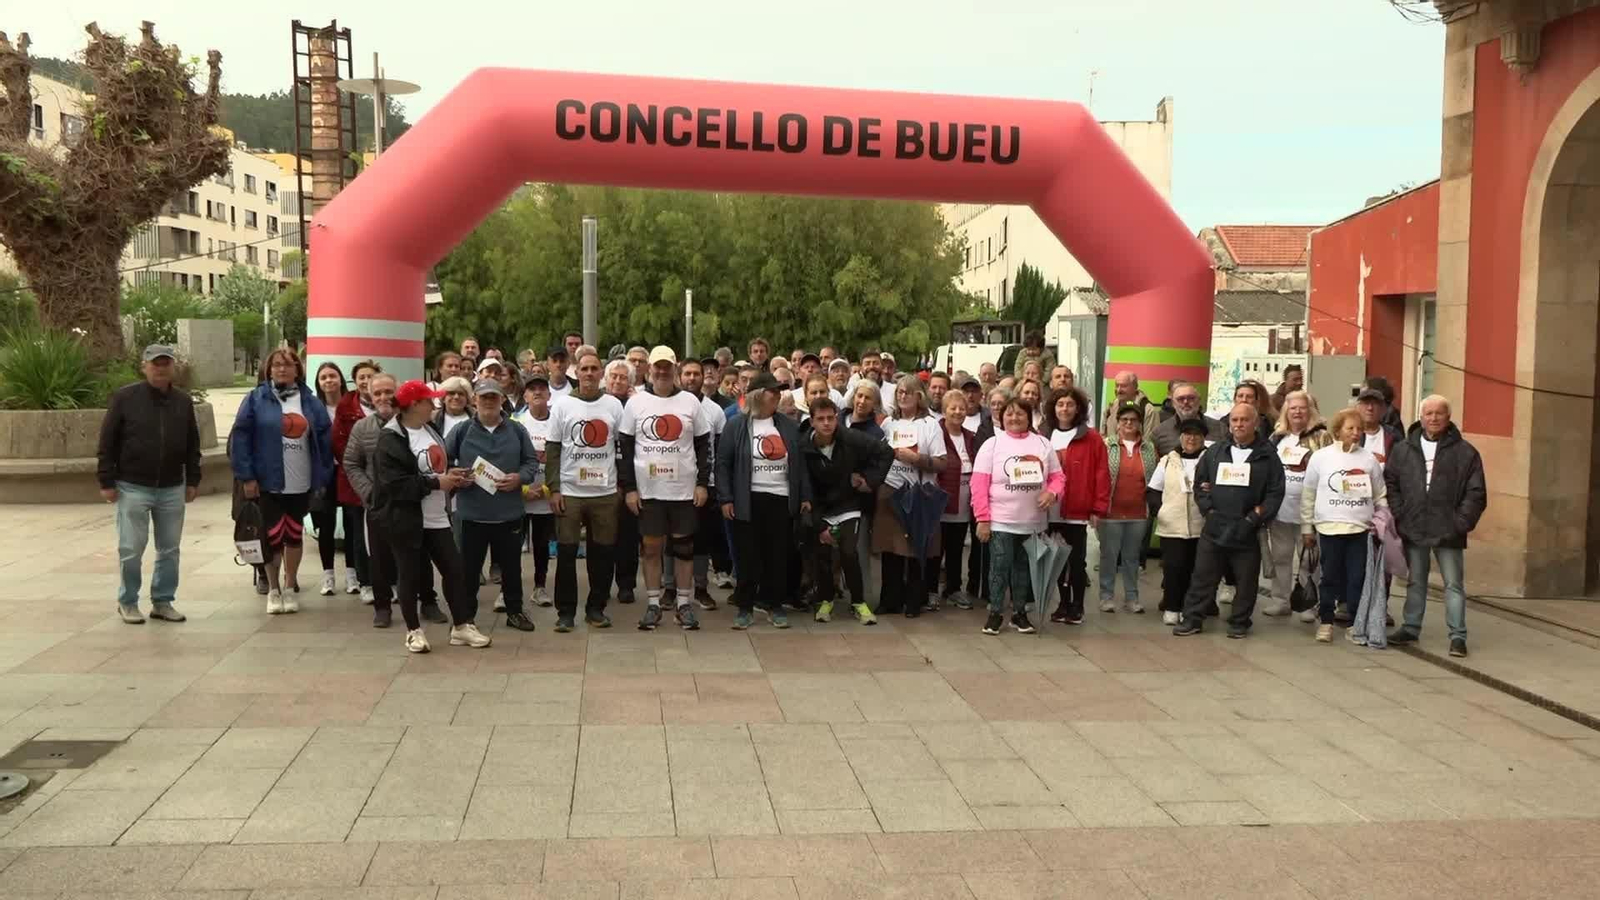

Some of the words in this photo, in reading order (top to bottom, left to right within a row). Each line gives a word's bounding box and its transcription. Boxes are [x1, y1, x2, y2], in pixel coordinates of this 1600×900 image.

[555, 99, 808, 154] CONCELLO
[822, 115, 881, 158] DE
[895, 119, 1020, 165] BUEU
[643, 444, 681, 455] apropark
